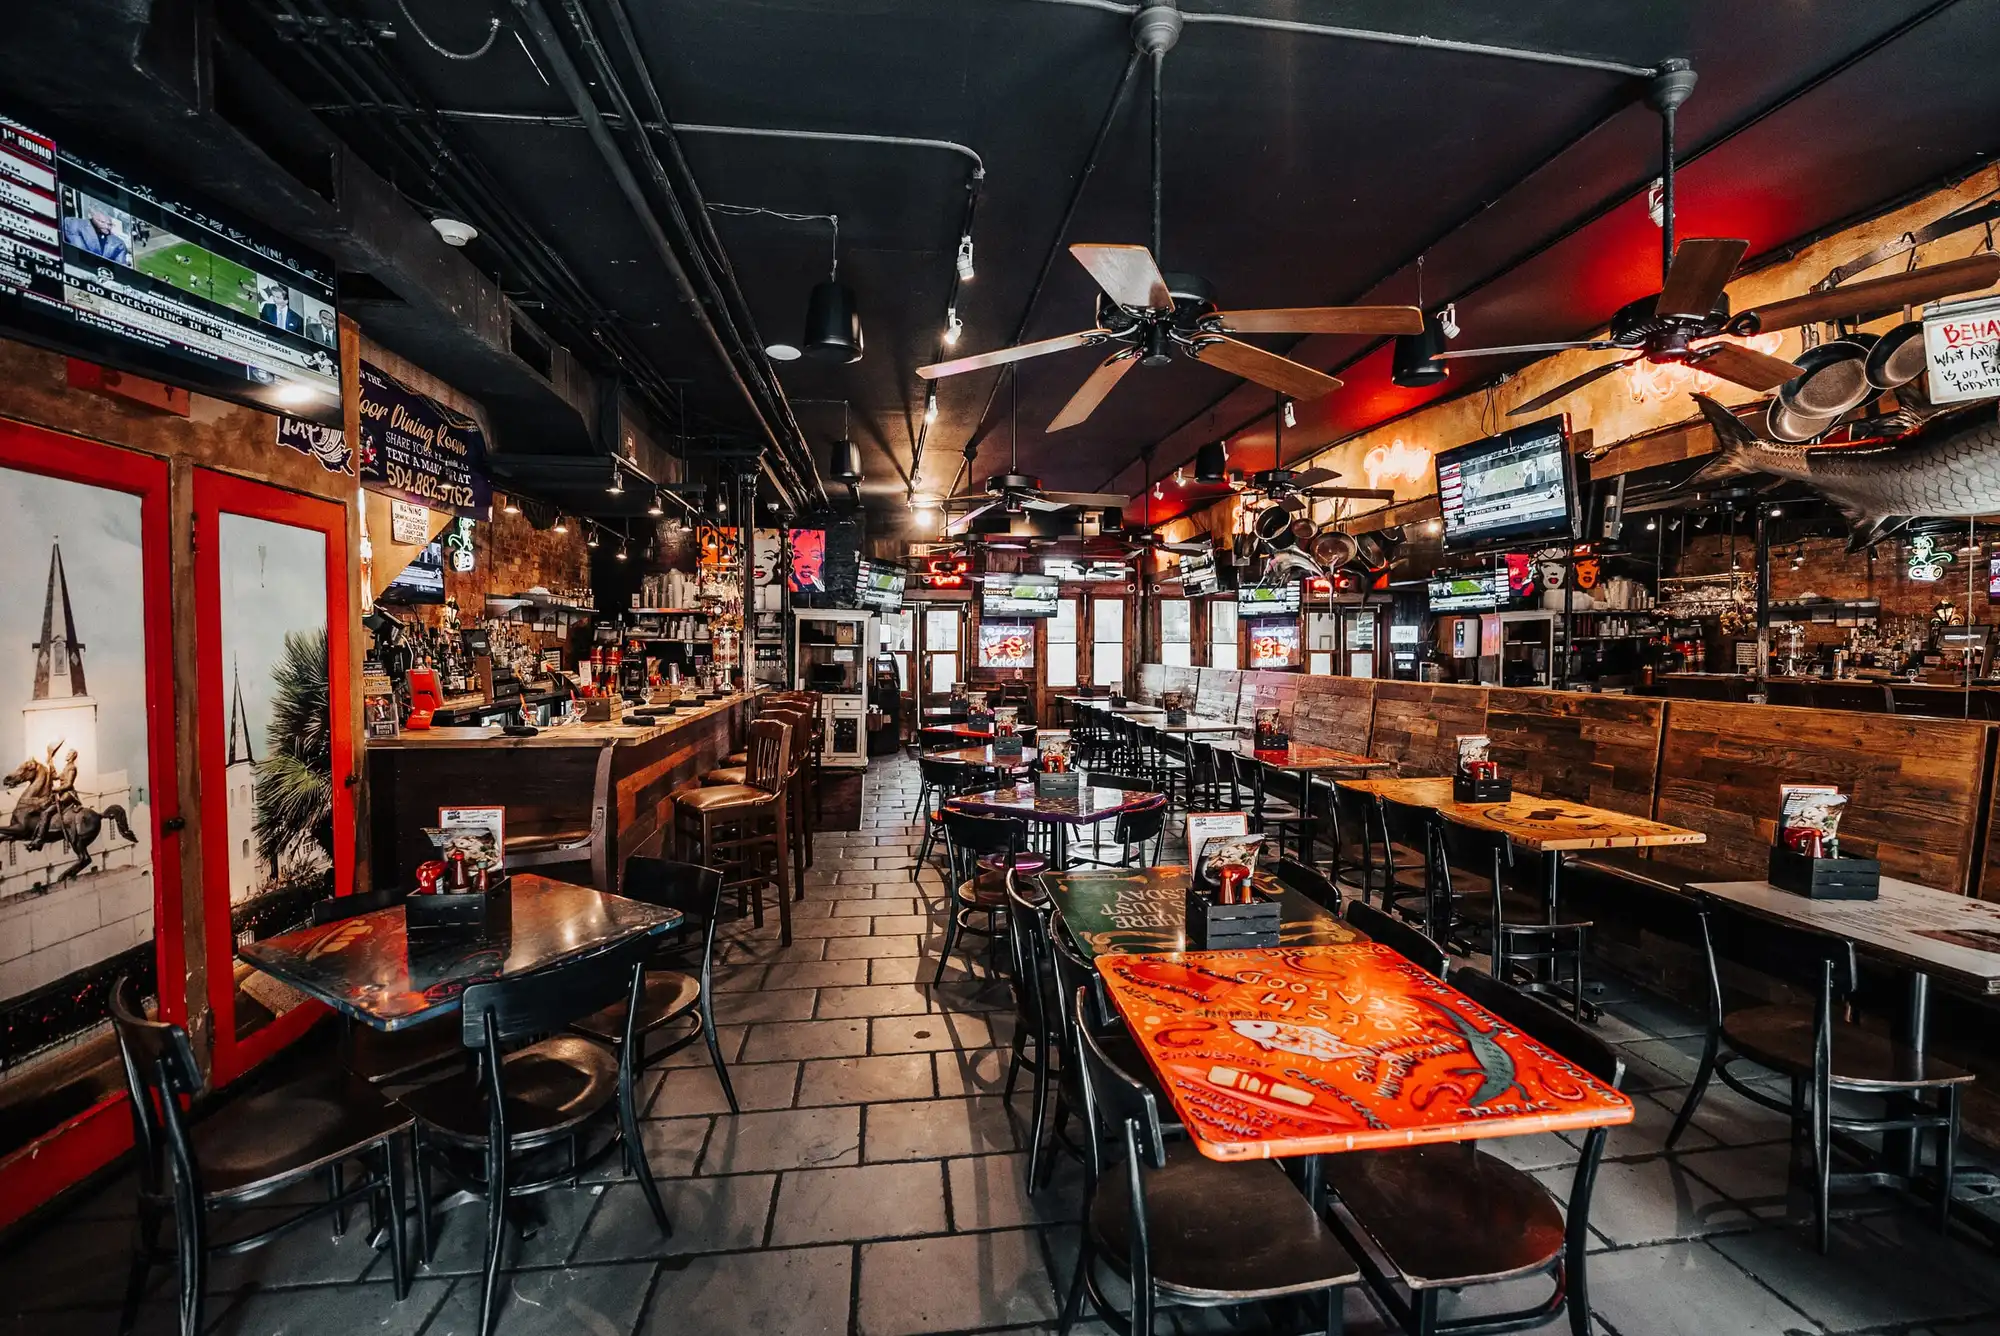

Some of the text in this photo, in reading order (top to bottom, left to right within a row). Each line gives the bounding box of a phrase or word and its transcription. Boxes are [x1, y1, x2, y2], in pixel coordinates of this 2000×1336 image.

[18, 136, 52, 160] ROUND
[7, 219, 54, 243] FLORIDA
[16, 244, 61, 268] DOES.
[35, 264, 80, 287] WOULD
[86, 283, 105, 296] DO
[111, 292, 184, 325] EVERYTHING
[189, 319, 202, 332] IN
[206, 328, 221, 339] MY
[88, 312, 109, 324] Green
[141, 331, 171, 345] Alabama
[236, 328, 249, 339] OUT
[248, 332, 267, 346] ABOUT
[267, 341, 292, 356] RODGERS
[1934, 349, 1964, 367] What
[1941, 369, 1957, 381] is
[1962, 368, 1978, 379] on
[386, 431, 411, 452] SHARE
[391, 403, 434, 453] Dining
[437, 423, 468, 457] Room
[386, 446, 410, 465] TEXT
[412, 456, 420, 468] A
[458, 473, 472, 485] AT
[1100, 901, 1162, 915] JUST
[1260, 991, 1423, 1032] FRESH
[1176, 1080, 1248, 1111] SOUTHERN
[1183, 1093, 1273, 1129] HOMEMADE
[1188, 1107, 1260, 1138] COOKING
